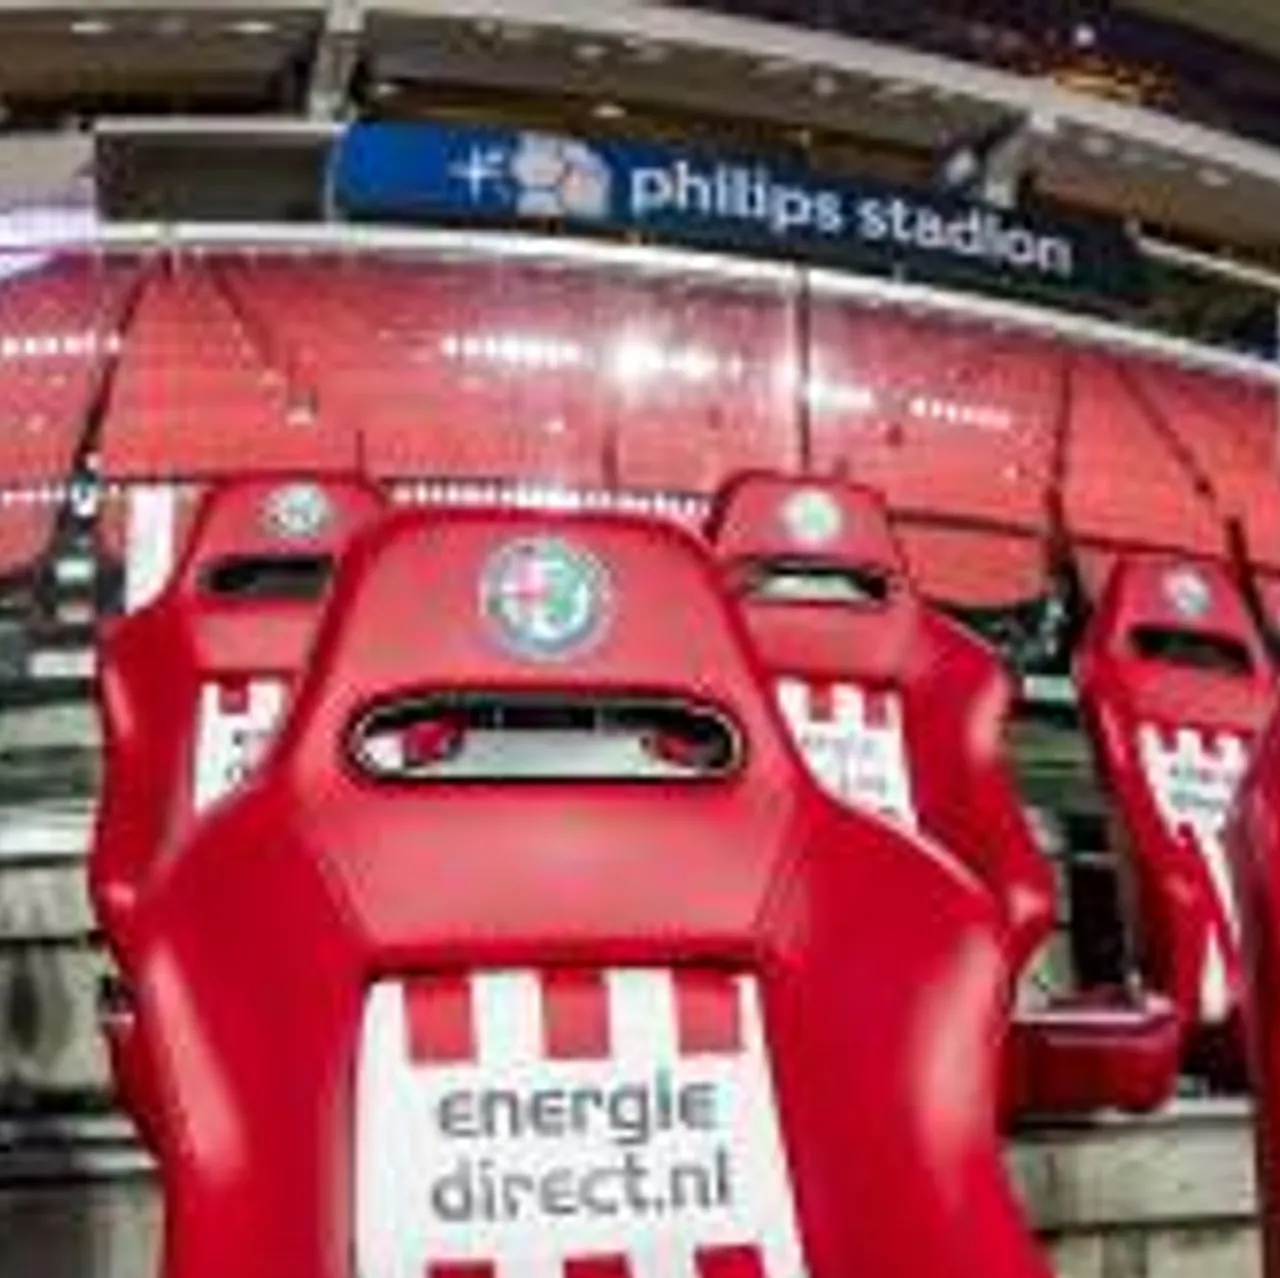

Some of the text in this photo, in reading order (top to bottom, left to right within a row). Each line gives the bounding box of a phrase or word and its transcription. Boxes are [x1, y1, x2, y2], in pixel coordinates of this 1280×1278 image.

[629, 160, 1073, 275] philips stadion
[437, 1066, 719, 1147] energie
[430, 1148, 730, 1224] direct.nl
